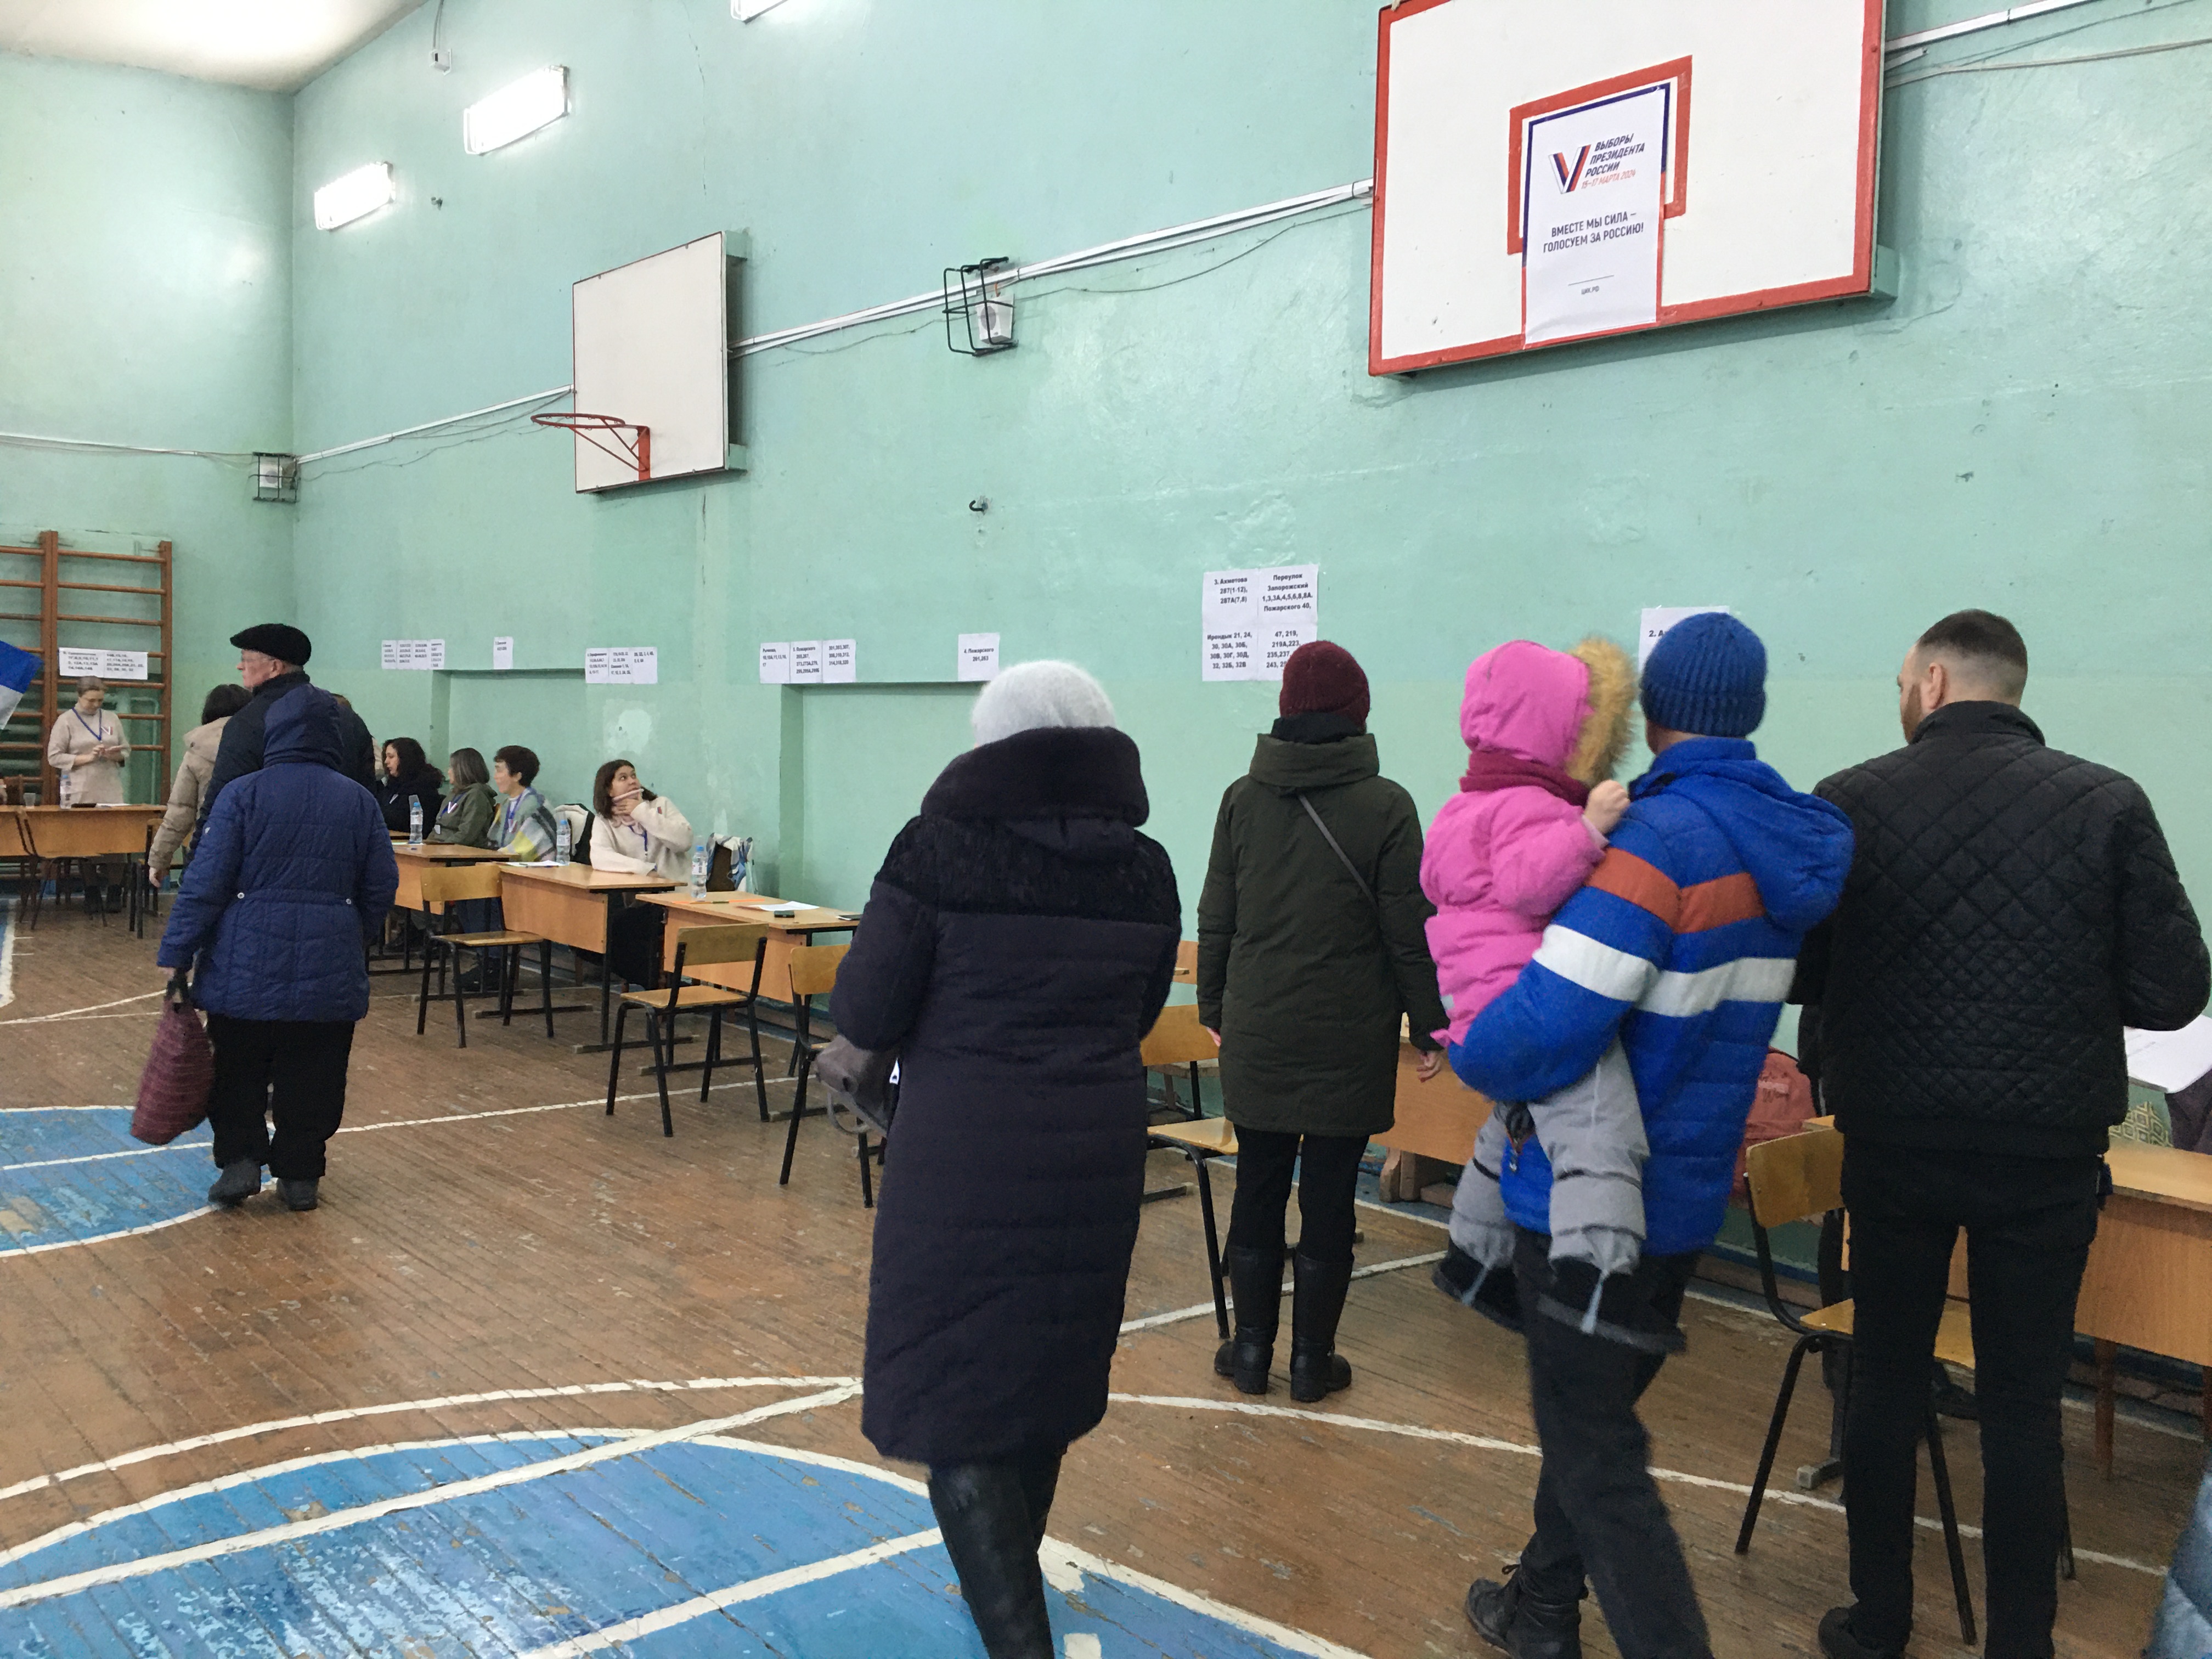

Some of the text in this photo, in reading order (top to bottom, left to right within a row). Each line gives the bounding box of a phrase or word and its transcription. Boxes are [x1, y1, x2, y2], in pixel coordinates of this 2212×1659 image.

[1594, 133, 1634, 151] ВЫБОРЫ
[1590, 143, 1645, 165] ПРЕЗИДЕНТА
[1585, 161, 1620, 178] РОССИИ
[1599, 173, 1619, 184] МАРТА
[1620, 168, 1636, 180] 2024
[1551, 221, 1584, 237] ВМЕСТЕ
[1586, 217, 1602, 229] МЫ
[1605, 211, 1628, 225] СИЛА
[1543, 222, 1644, 253] ГОЛОСУЕМ ЗА РОССИЮ!
[1273, 573, 1302, 581] Переулок
[1267, 583, 1308, 591] Запорожский
